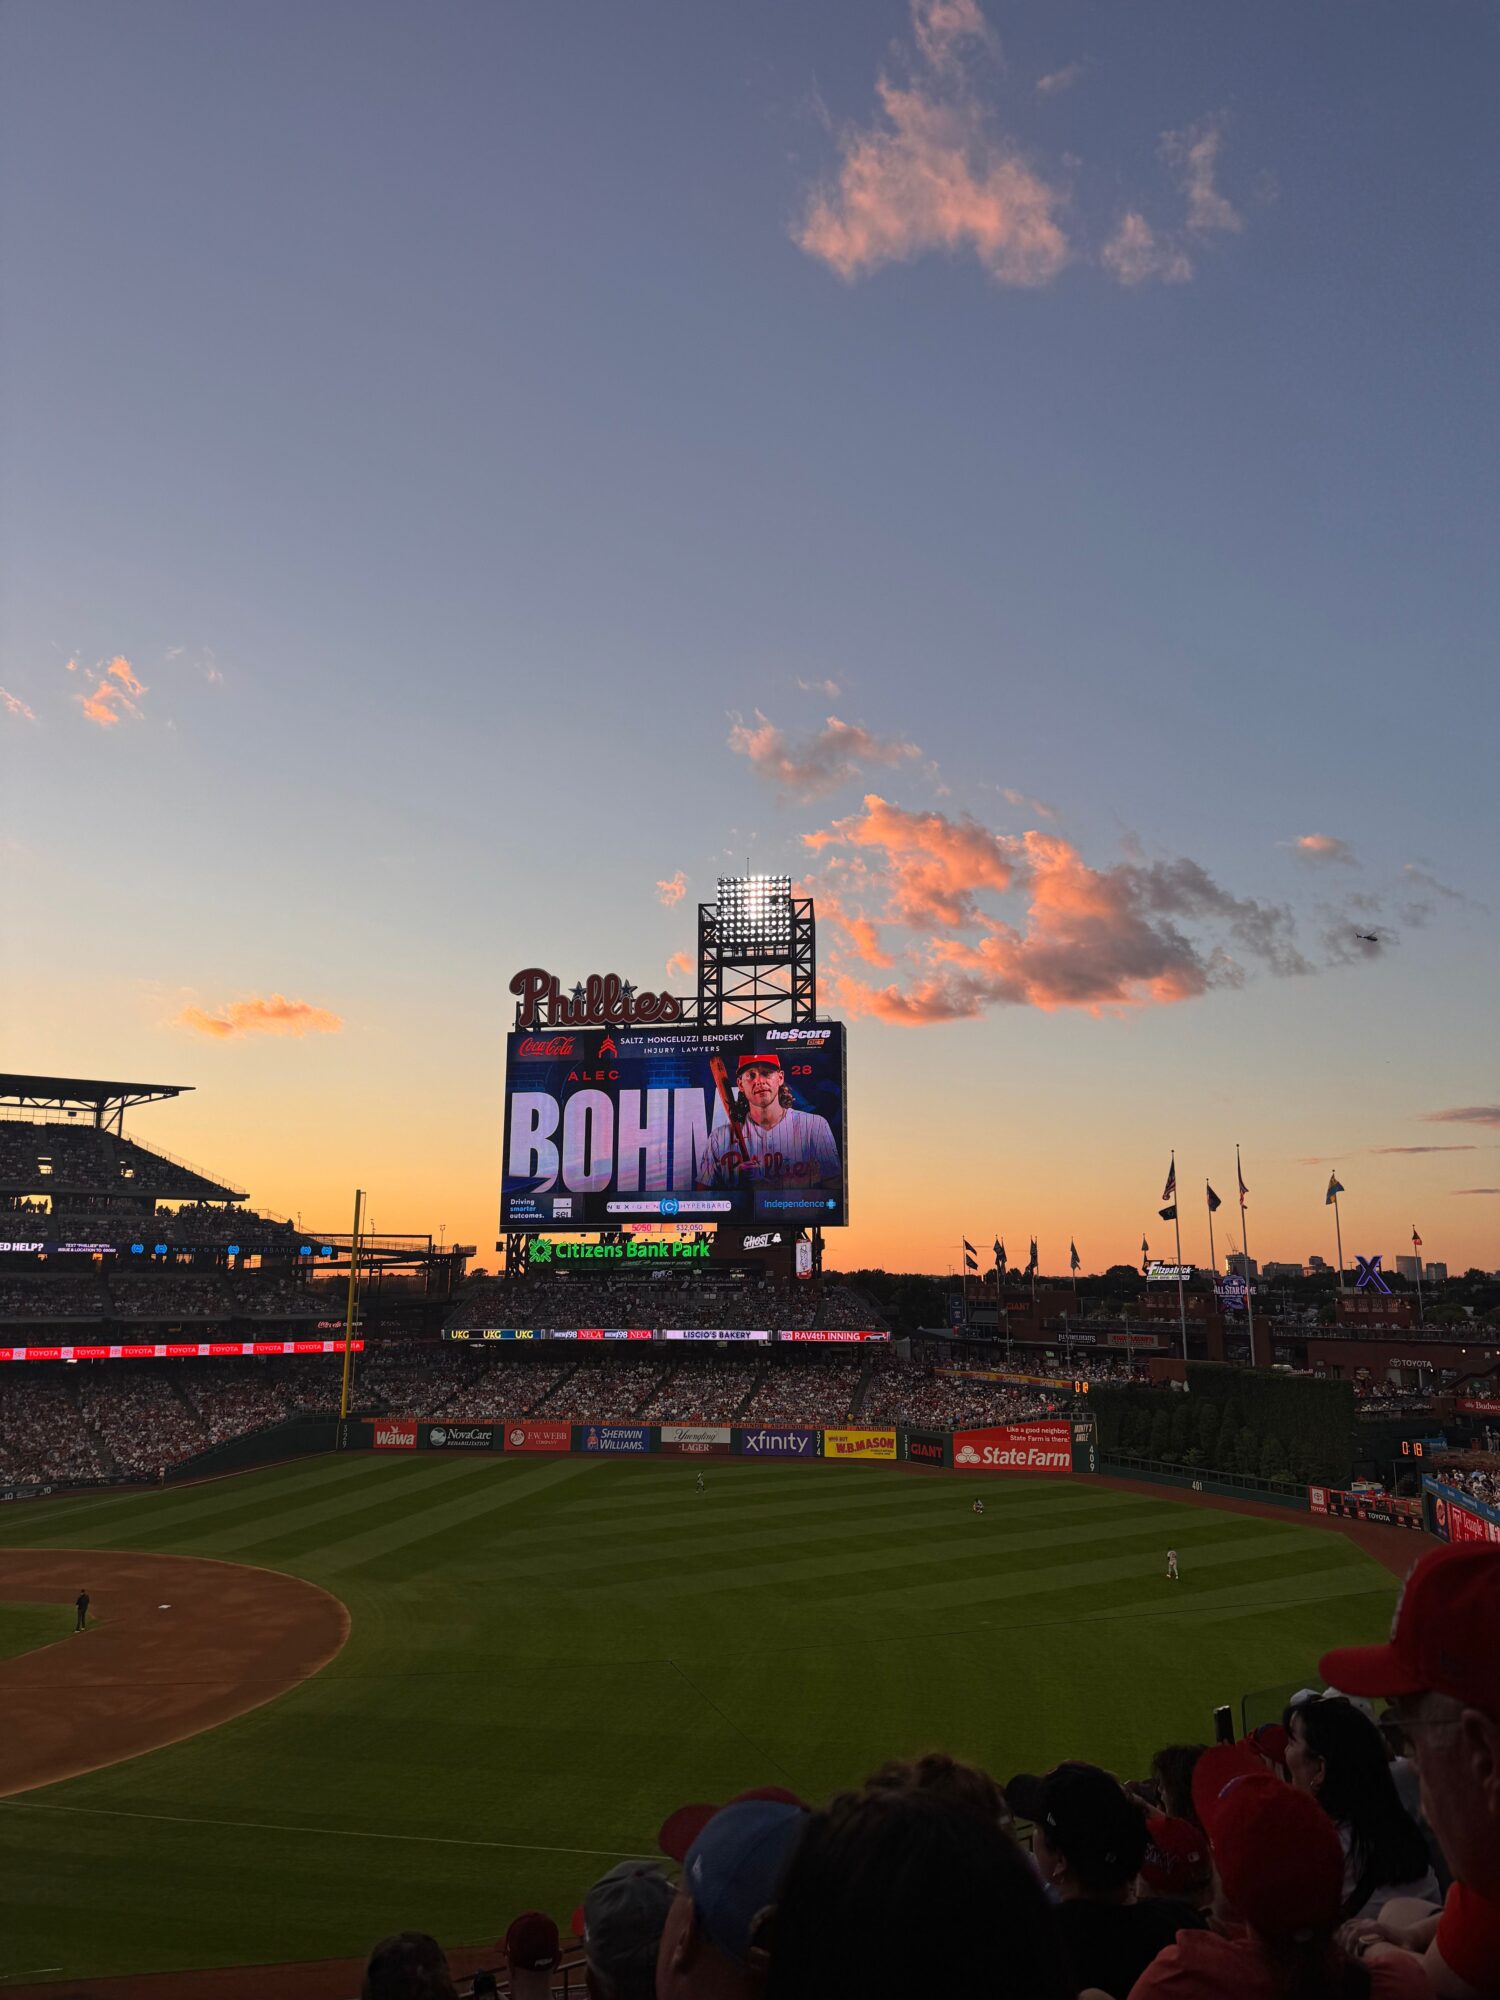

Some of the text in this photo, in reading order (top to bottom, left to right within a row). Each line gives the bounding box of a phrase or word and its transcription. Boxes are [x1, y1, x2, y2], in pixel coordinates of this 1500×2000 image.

[509, 968, 680, 1026] Phillies
[620, 1033, 744, 1045] SALTZ MONGELUZZI BENDESKY
[766, 1028, 831, 1041] theScore
[568, 1070, 619, 1080] ALEC
[791, 1065, 812, 1075] 28
[509, 1087, 740, 1193] BOHM
[510, 1199, 535, 1207] Driving
[764, 1200, 825, 1209] Independence
[12, 1242, 44, 1252] HELP?
[743, 1232, 774, 1251] GHOST
[555, 1239, 710, 1258] Citizens Bank Park
[1213, 1285, 1225, 1295] ALL
[1225, 1285, 1240, 1295] STAR
[451, 1330, 534, 1339] UKG UKG UKG
[683, 1331, 751, 1339] LISCIO'S BAKERY
[794, 1331, 860, 1340] RAV4th INNING
[1402, 1360, 1432, 1369] TOYOTA
[376, 1431, 415, 1444] Wawa
[447, 1428, 492, 1440] NovaCare
[544, 1432, 567, 1440] WEBB
[601, 1428, 643, 1439] SHERWIN
[674, 1429, 716, 1443] Yuengling
[1041, 1428, 1069, 1436] neighbor,
[746, 1431, 808, 1452] xfinity
[681, 1443, 709, 1452] LAGER
[911, 1443, 942, 1457] GIANT
[1401, 1441, 1423, 1457] 0:18
[1191, 1480, 1203, 1491] 401
[1367, 1512, 1391, 1522] TOYOTA
[1462, 1512, 1483, 1536] Temple
